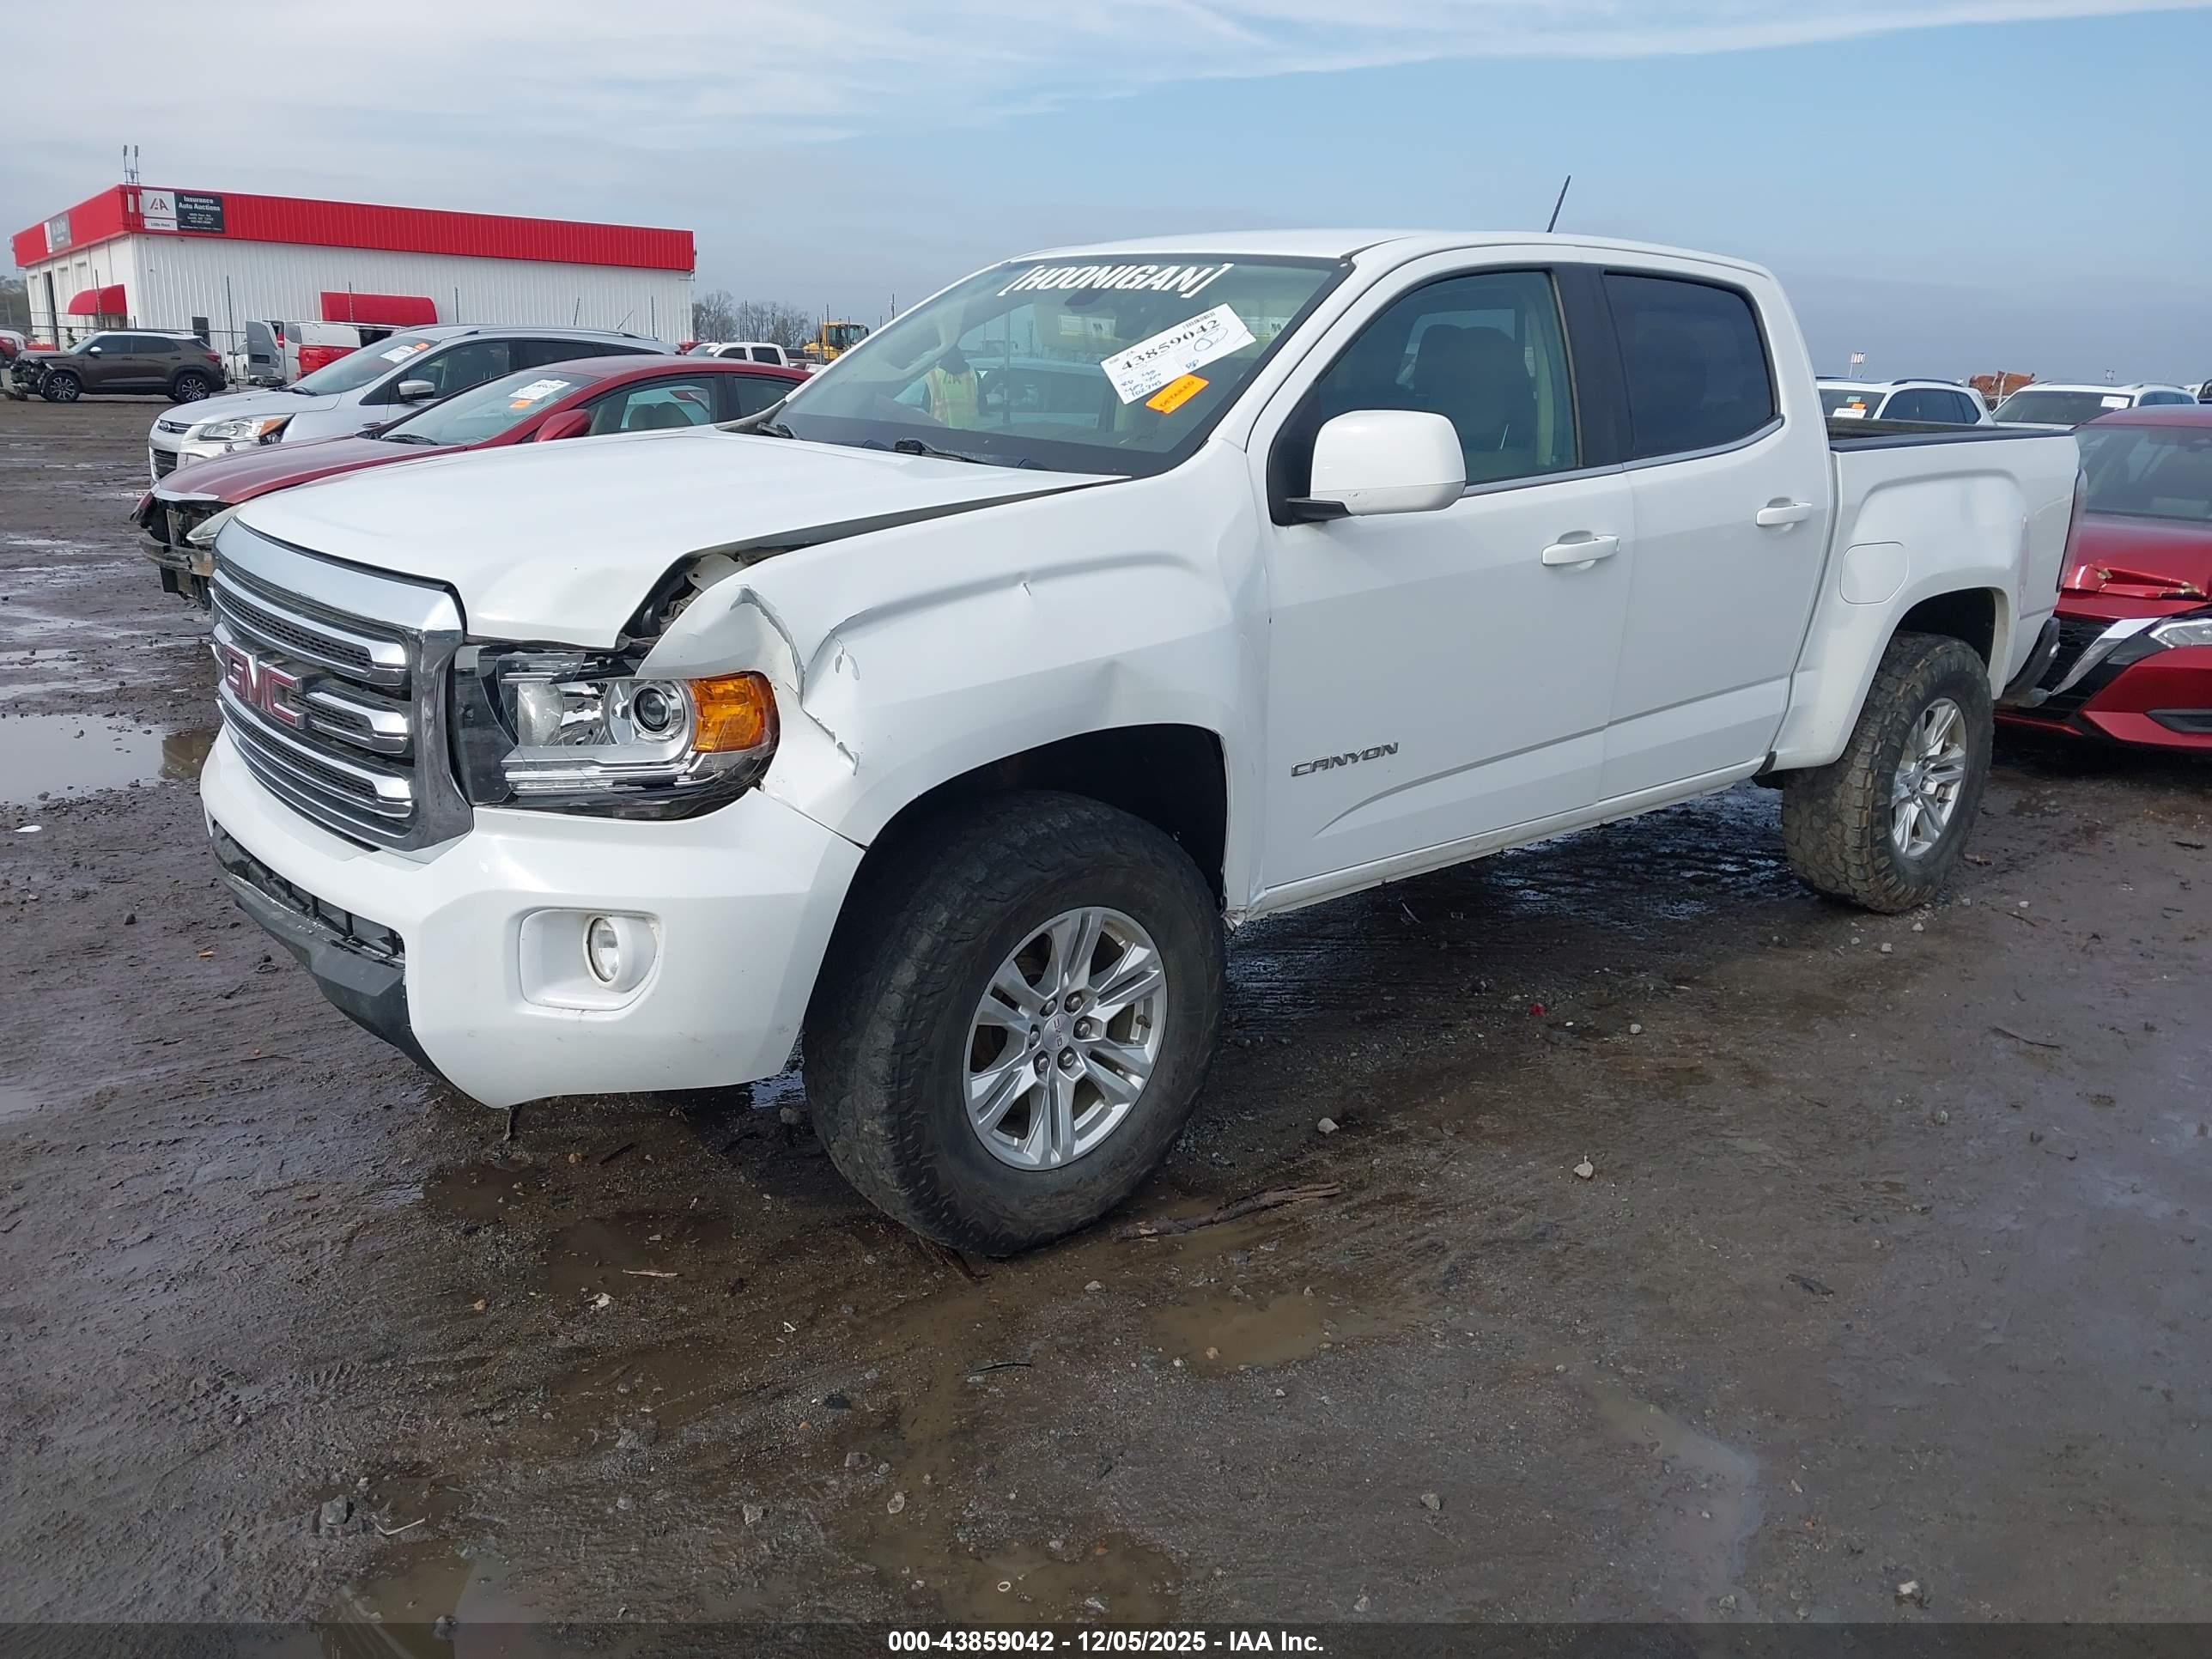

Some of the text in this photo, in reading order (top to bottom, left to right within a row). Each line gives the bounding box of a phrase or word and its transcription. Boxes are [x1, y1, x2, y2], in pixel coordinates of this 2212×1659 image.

[183, 195, 214, 204] Insurance
[193, 203, 221, 211] Auctions
[1121, 319, 1221, 371] 43859042
[224, 641, 307, 730] GMC
[1291, 741, 1399, 777] CANYON
